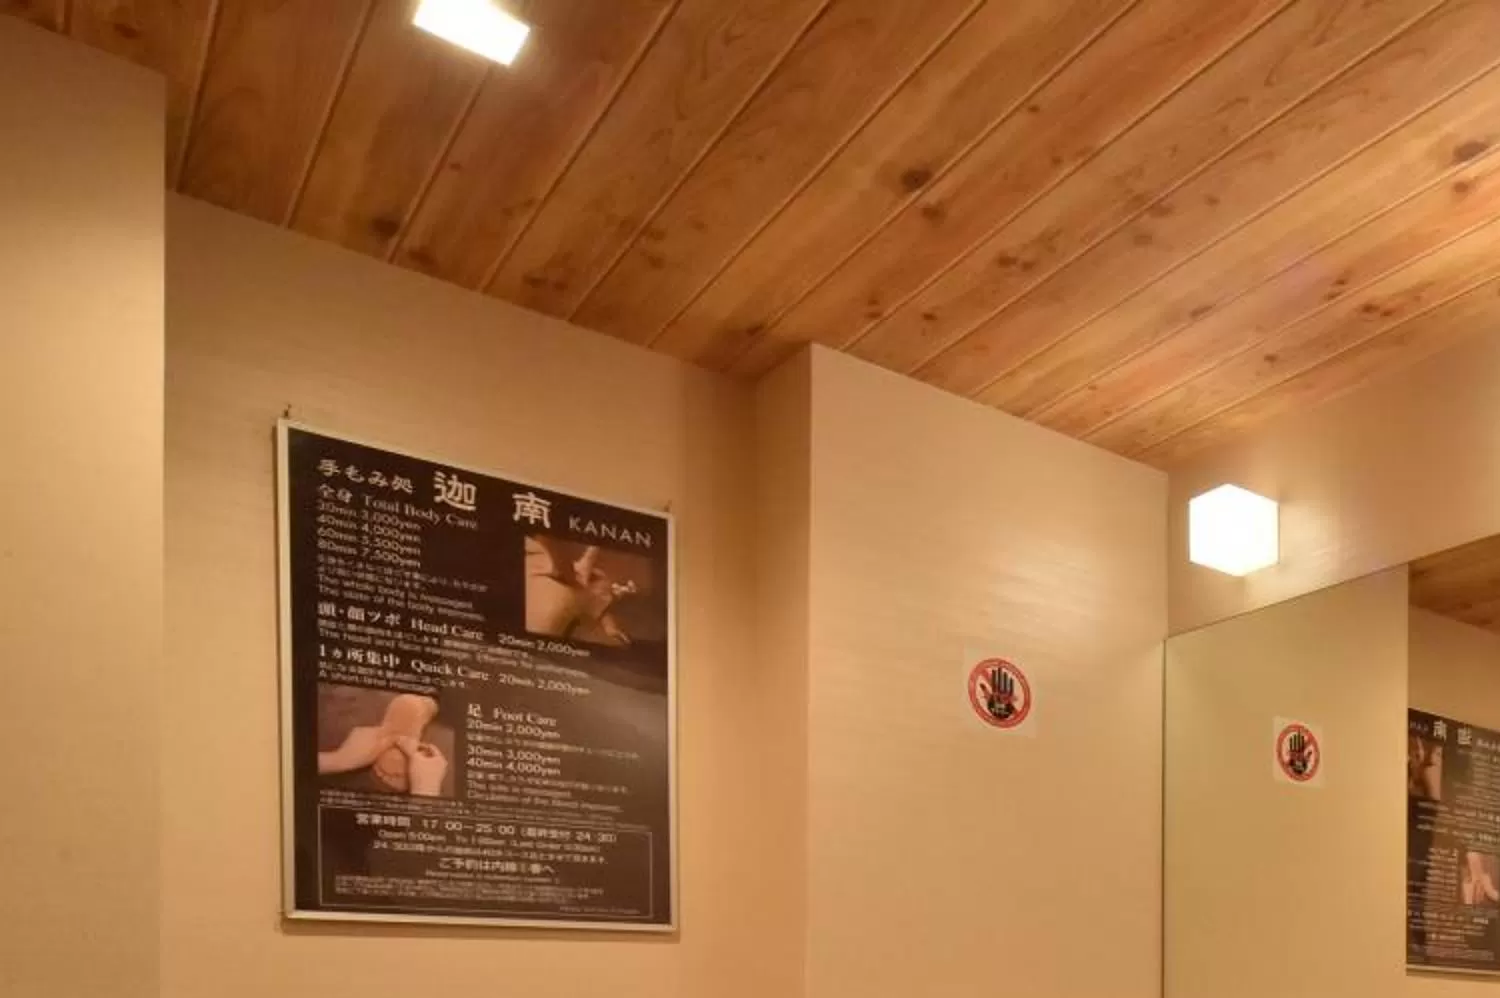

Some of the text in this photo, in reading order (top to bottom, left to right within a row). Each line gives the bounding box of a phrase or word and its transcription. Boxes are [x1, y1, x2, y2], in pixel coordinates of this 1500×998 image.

[319, 459, 651, 548] 手もみ処 迦 南 KANAN
[319, 483, 478, 530] 全身 Total Body Care
[411, 616, 447, 635] Head
[451, 623, 484, 641] Care
[410, 657, 452, 676] Quick
[457, 664, 488, 680] Care
[493, 707, 523, 722] Foot
[526, 711, 557, 726] Care
[467, 744, 502, 758] 30min
[467, 756, 502, 769] 40min
